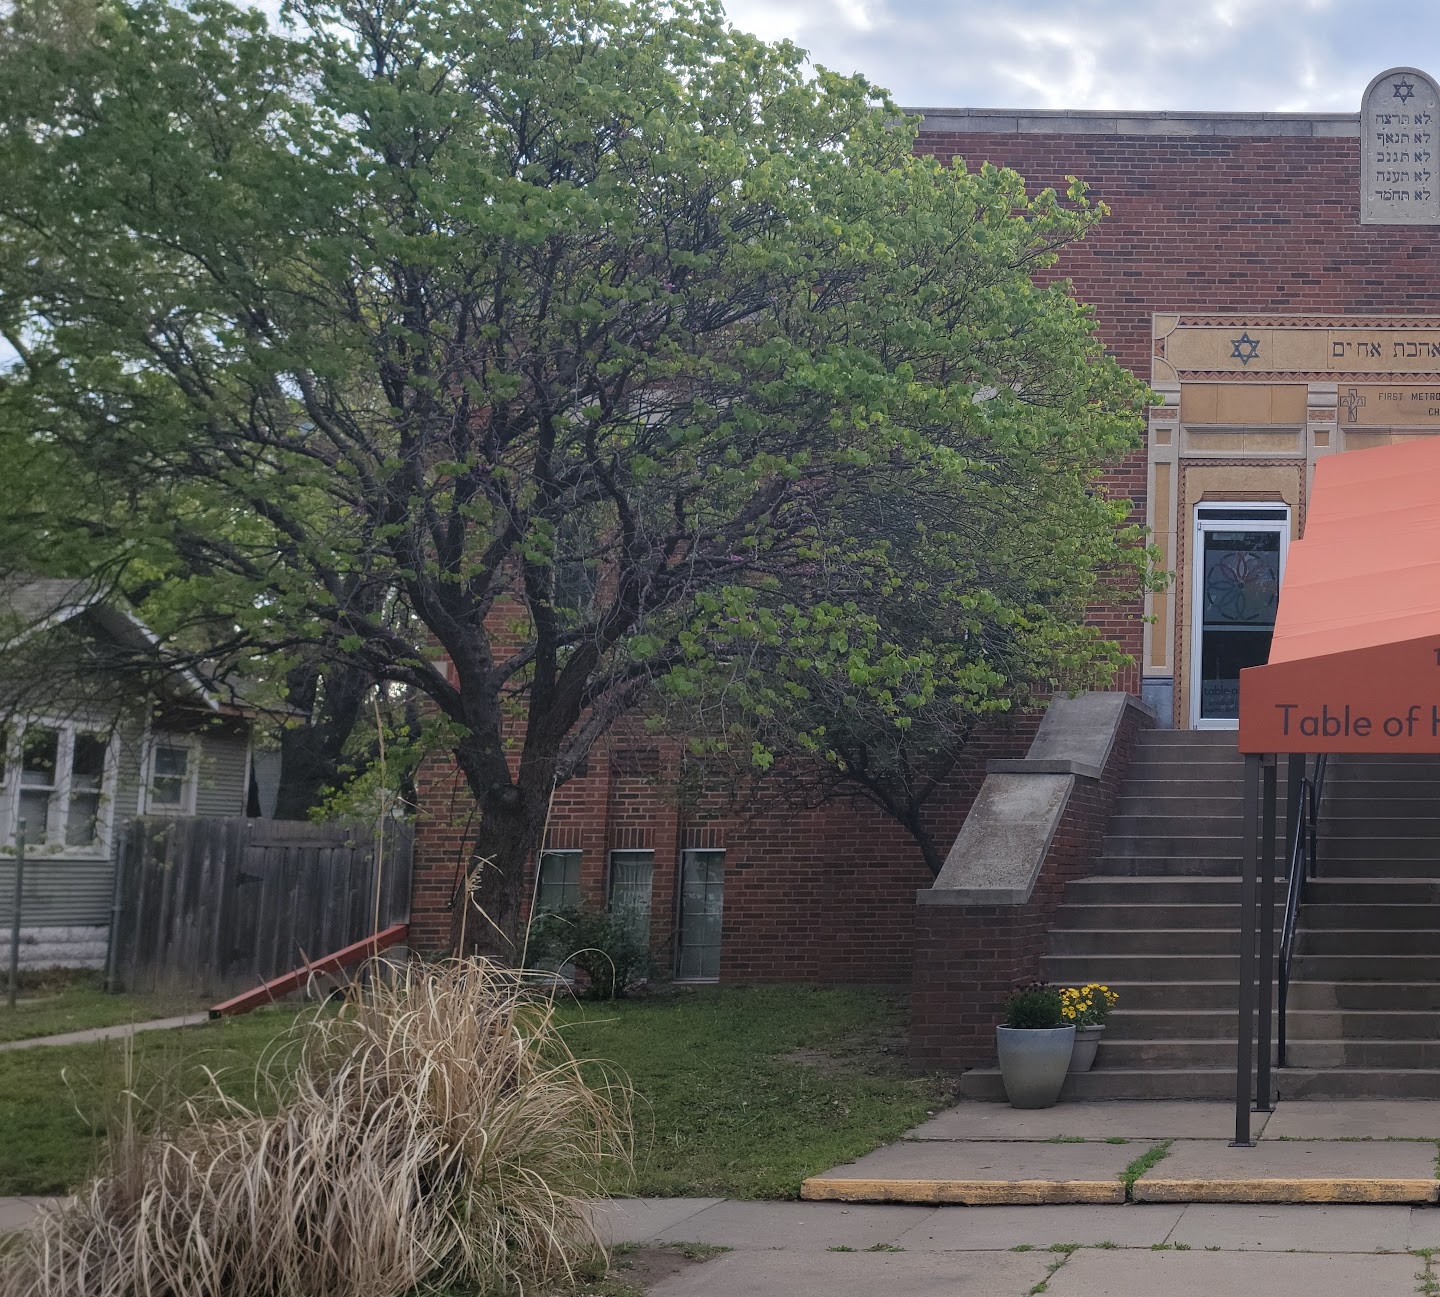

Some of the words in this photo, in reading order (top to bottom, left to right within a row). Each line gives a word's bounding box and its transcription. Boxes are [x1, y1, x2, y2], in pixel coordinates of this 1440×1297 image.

[1414, 110, 1431, 125] לא
[1413, 130, 1431, 144] לא
[1413, 148, 1431, 163] לא
[1413, 167, 1431, 182] לא
[1414, 186, 1431, 201] לא
[1332, 341, 1382, 357] אחים
[1378, 392, 1403, 400] FIRST
[1274, 703, 1372, 737] Table
[1383, 704, 1421, 737] of
